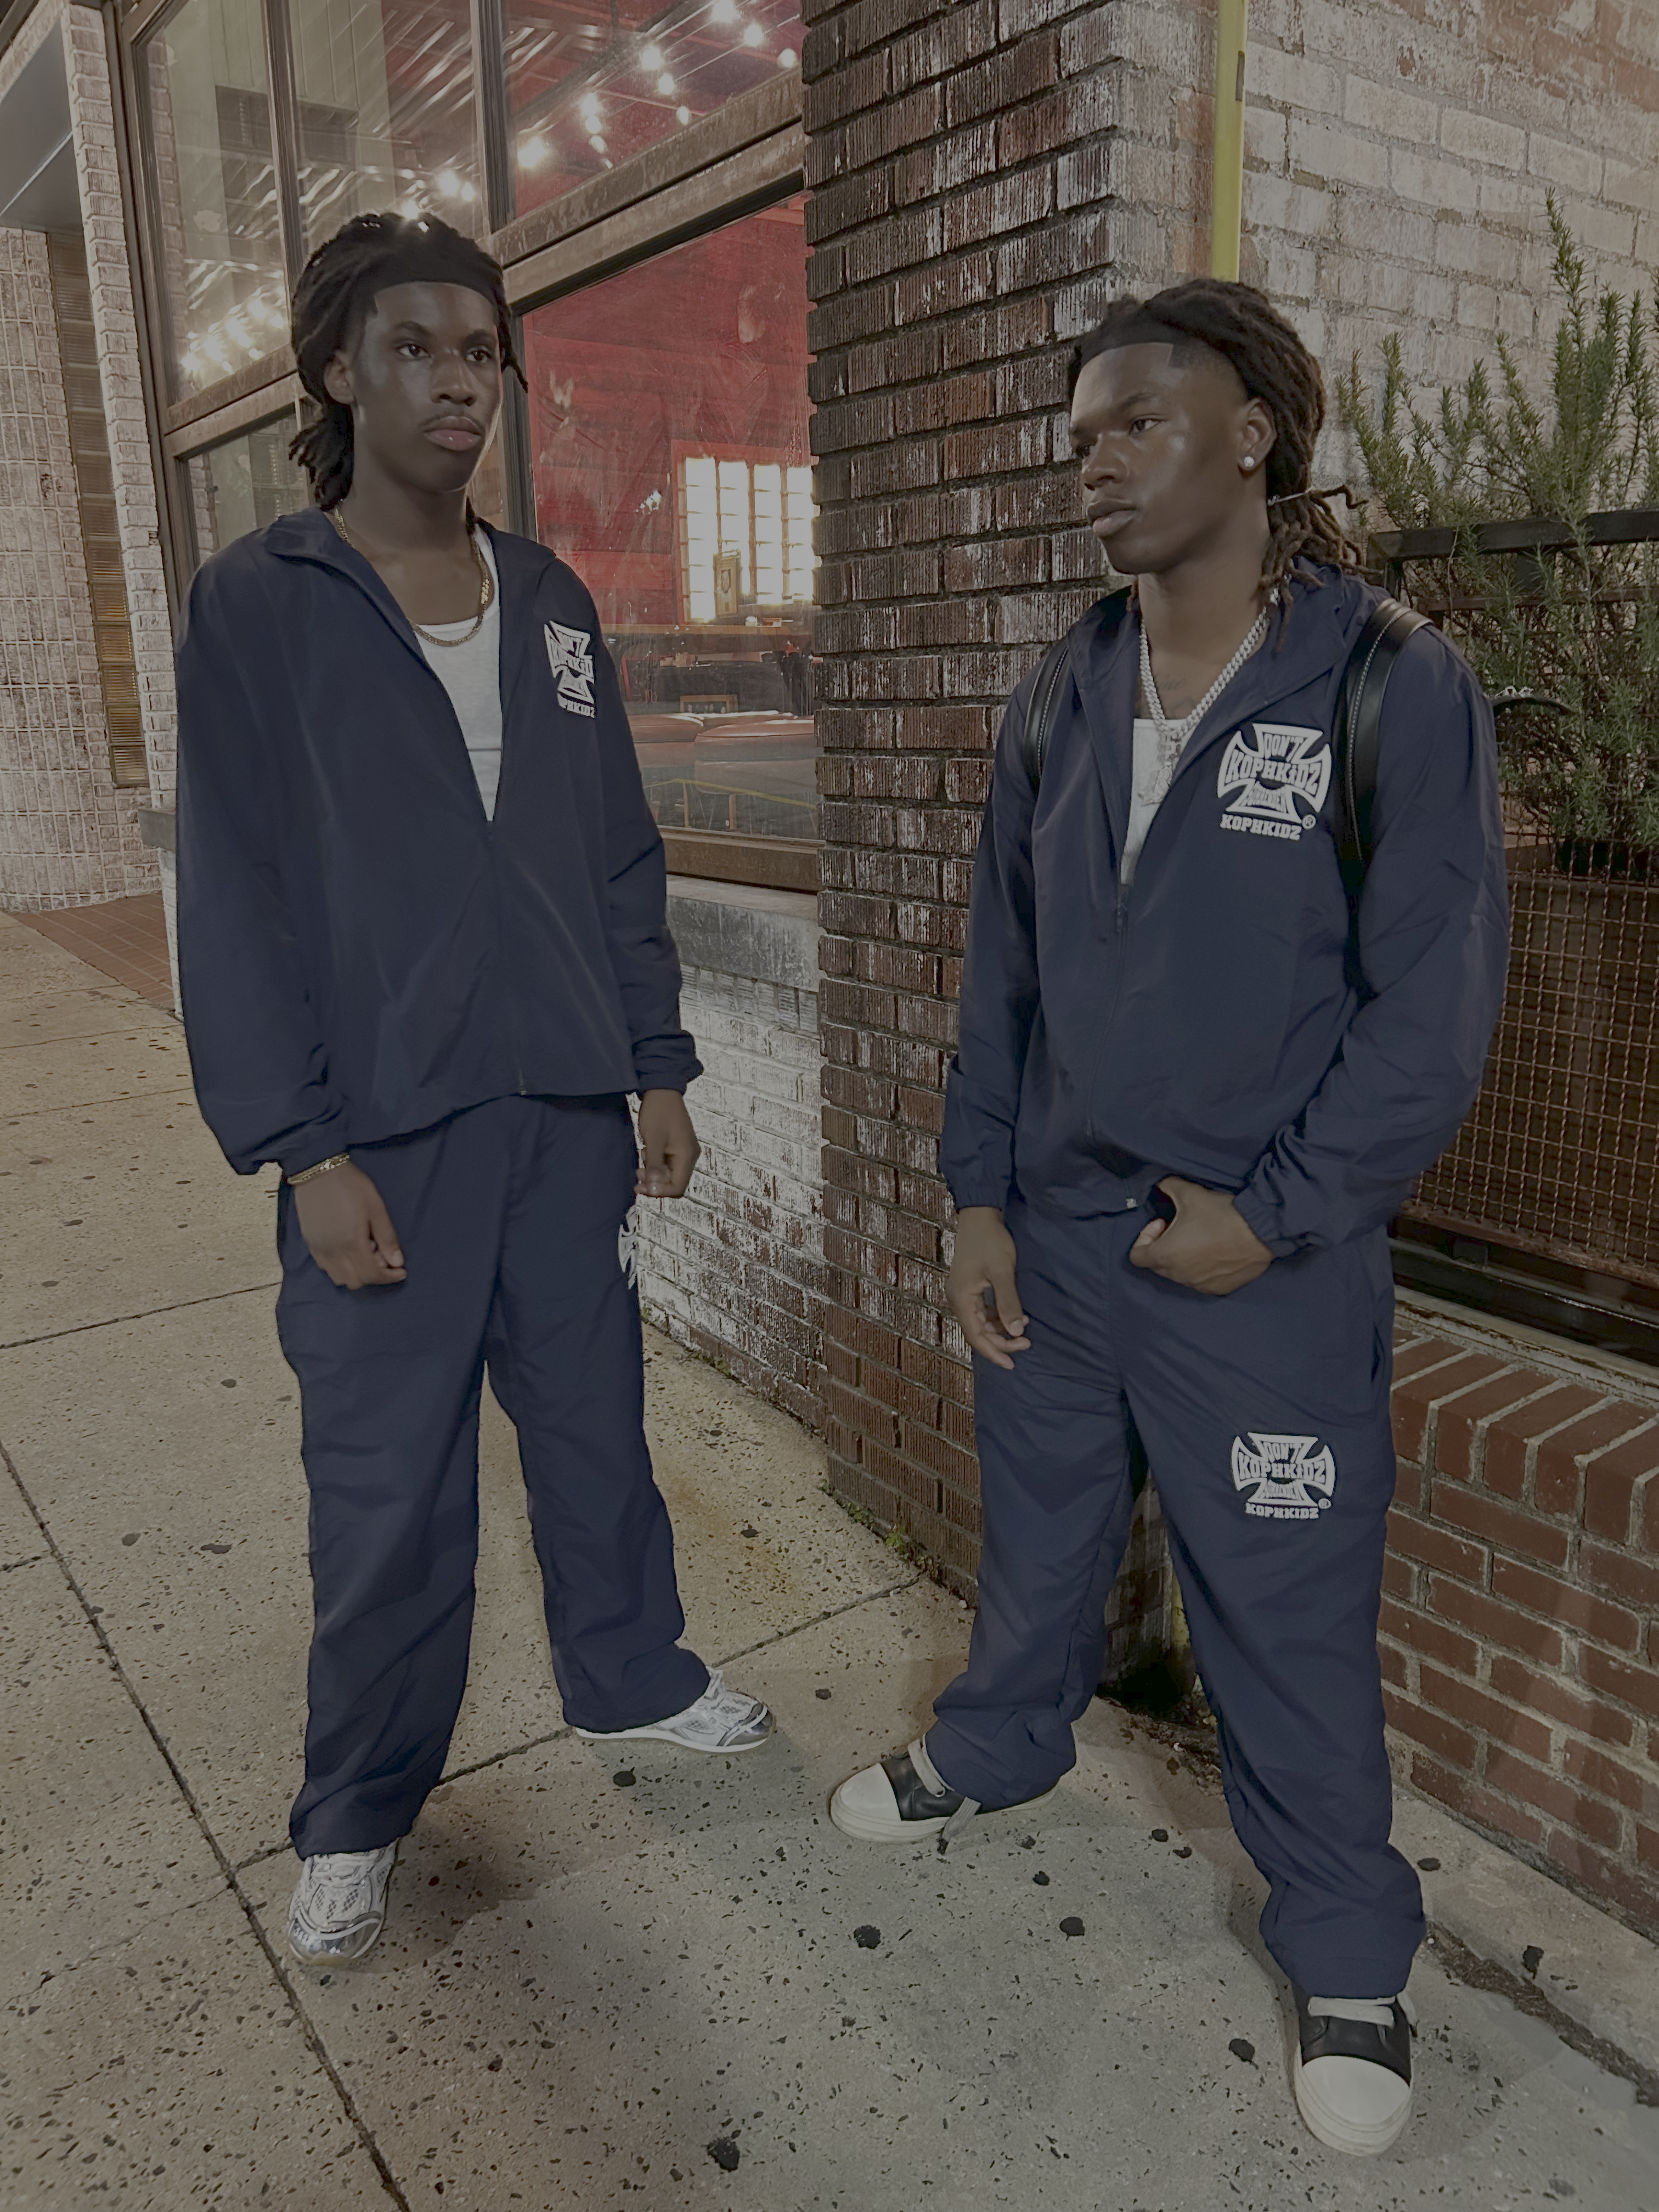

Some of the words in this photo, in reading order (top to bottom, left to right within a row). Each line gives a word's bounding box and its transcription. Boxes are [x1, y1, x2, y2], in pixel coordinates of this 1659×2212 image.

[1264, 733, 1304, 762] DON'T
[1220, 814, 1302, 841] KOPHKIDZ
[1263, 1442, 1302, 1463] DON'T
[1245, 1502, 1319, 1519] KOPHKIDZ
